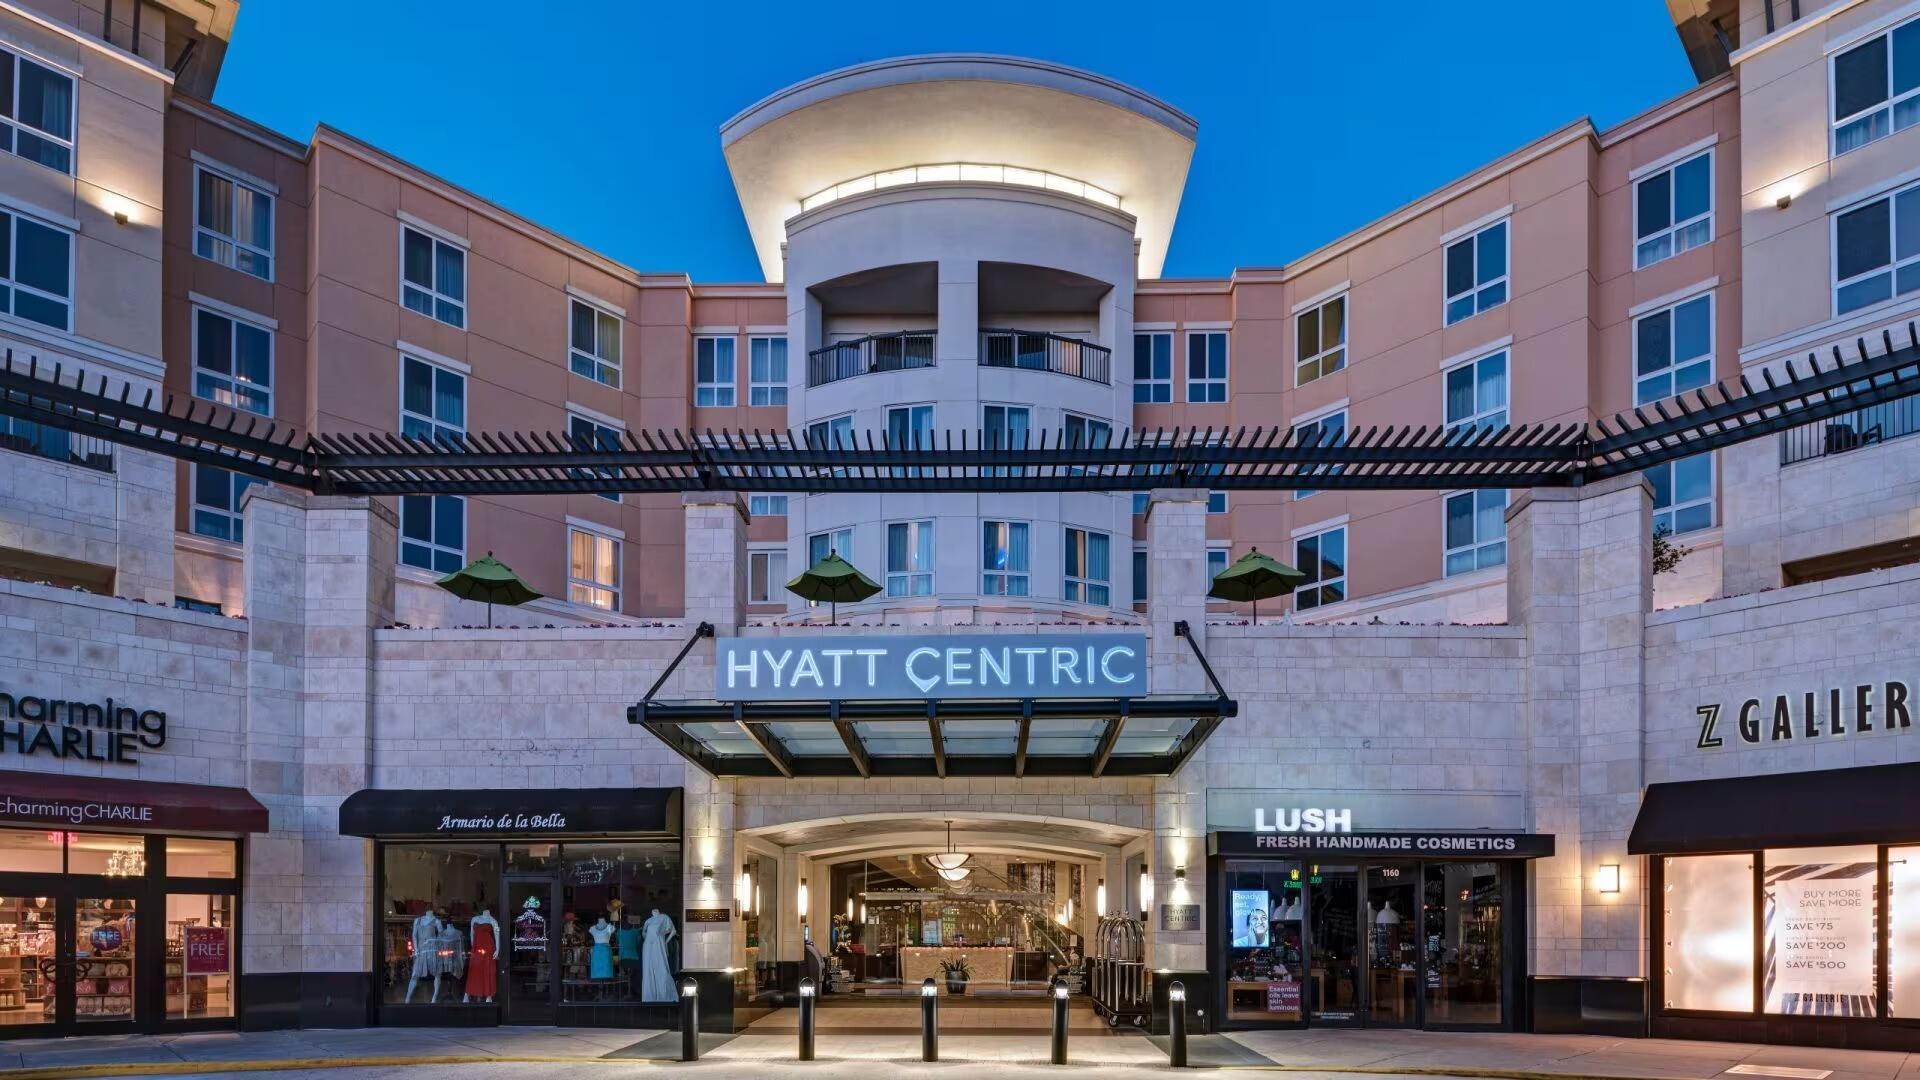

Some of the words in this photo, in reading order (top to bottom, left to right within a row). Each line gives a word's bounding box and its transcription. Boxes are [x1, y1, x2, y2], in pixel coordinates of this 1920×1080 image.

[728, 649, 887, 688] HYATT
[905, 646, 1135, 693] CENTRIC
[1696, 704, 1723, 748] Z
[1739, 681, 1911, 743] GALLER
[437, 814, 495, 830] Armario
[496, 814, 512, 828] de
[515, 813, 529, 828] la
[531, 813, 566, 828] Bella
[1254, 808, 1352, 833] LUSH
[1256, 835, 1311, 848] FRESH
[1316, 836, 1411, 849] HANDMADE
[1416, 837, 1516, 850] COSMETICS
[1383, 869, 1400, 877] 1160
[1803, 890, 1825, 898] BUY
[1828, 889, 1861, 897] MORE
[1800, 900, 1825, 908] SAVE
[1816, 922, 1833, 930] $75
[190, 943, 225, 956] FREE
[1785, 942, 1813, 950] SAVE
[1816, 942, 1846, 950] $200
[1785, 961, 1813, 969] SAVE
[1816, 961, 1846, 969] $500
[1269, 985, 1299, 993] Essential
